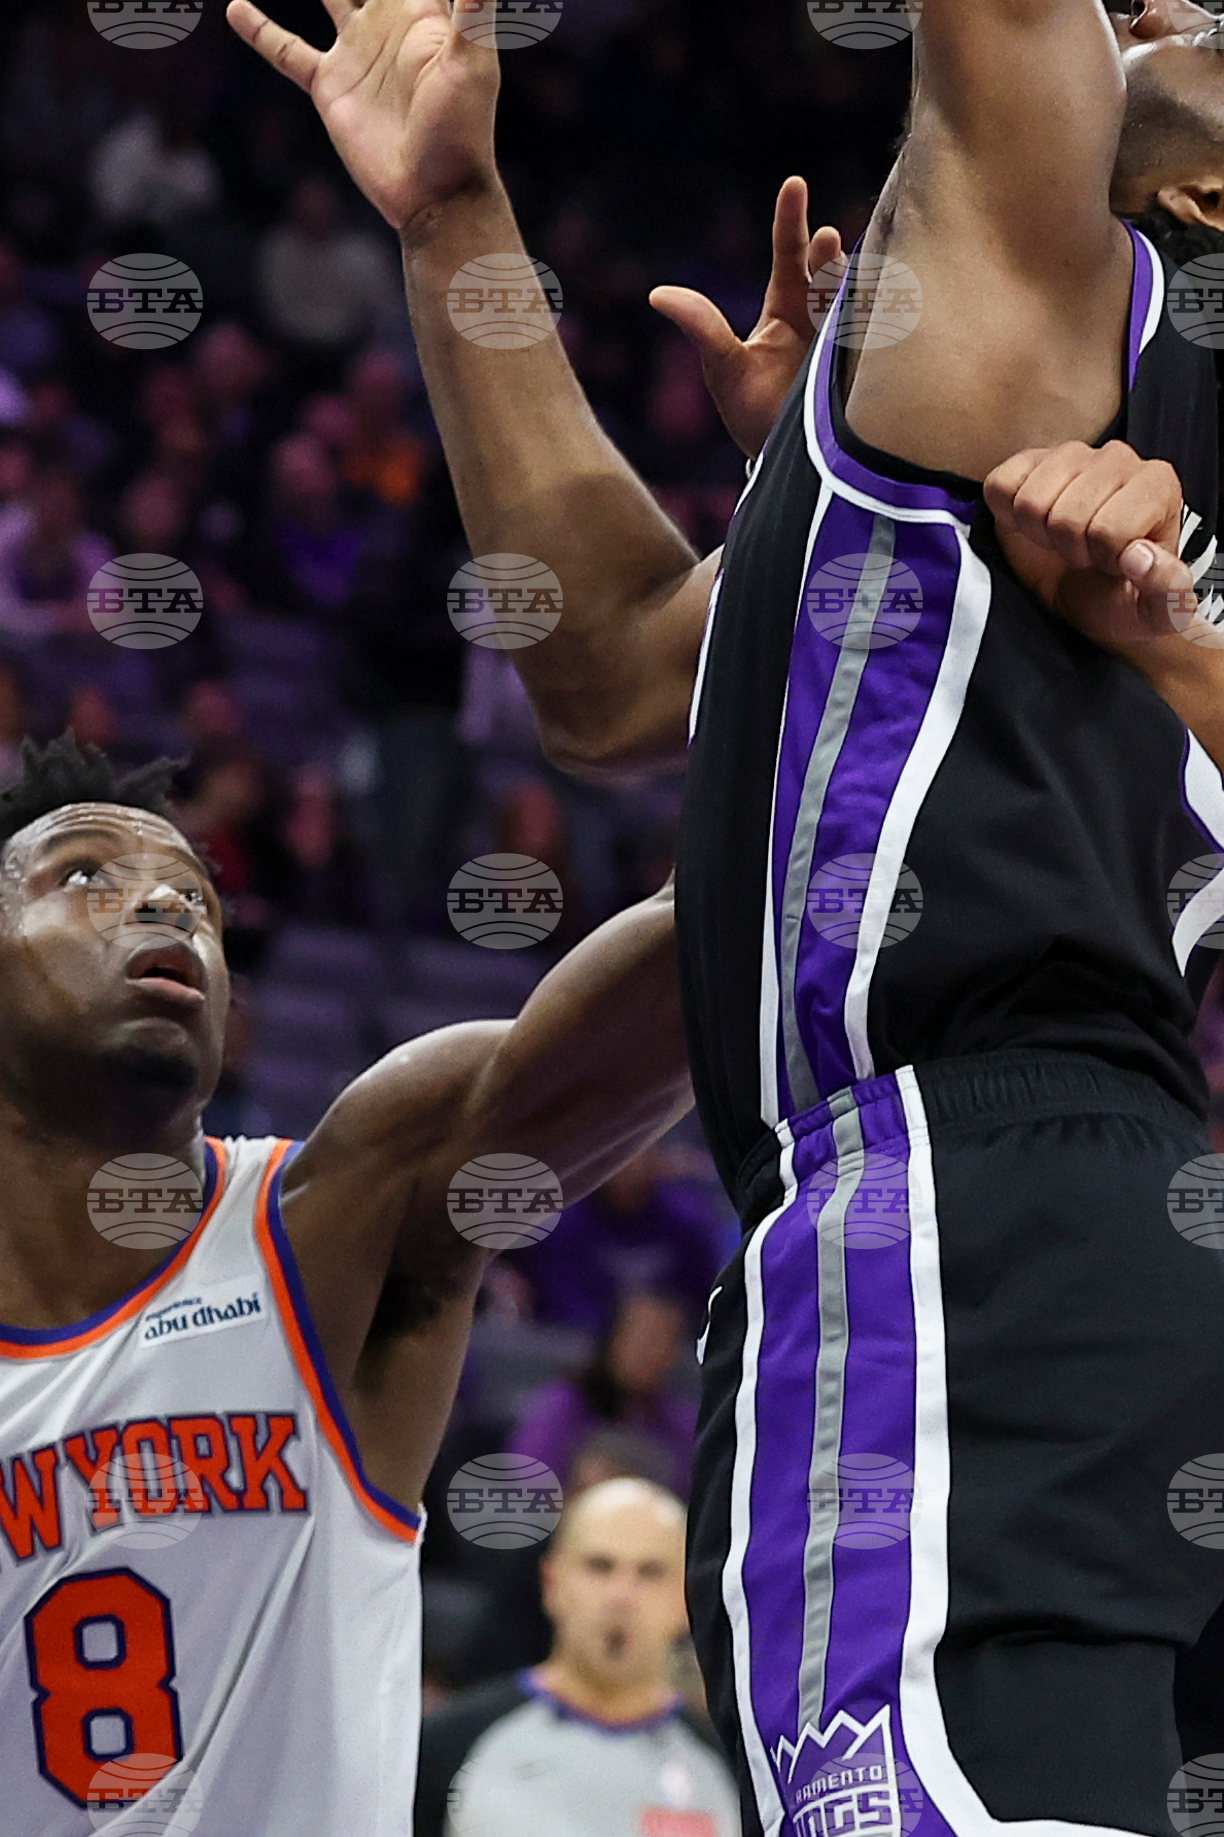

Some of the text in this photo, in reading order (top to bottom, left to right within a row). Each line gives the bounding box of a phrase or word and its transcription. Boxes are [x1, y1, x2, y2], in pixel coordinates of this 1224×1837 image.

[144, 1314, 188, 1340] abu
[192, 1292, 261, 1327] dhabi
[0, 1410, 310, 1567] W YORK
[24, 1566, 184, 1810] 8
[795, 1764, 883, 1804] RAMENTO
